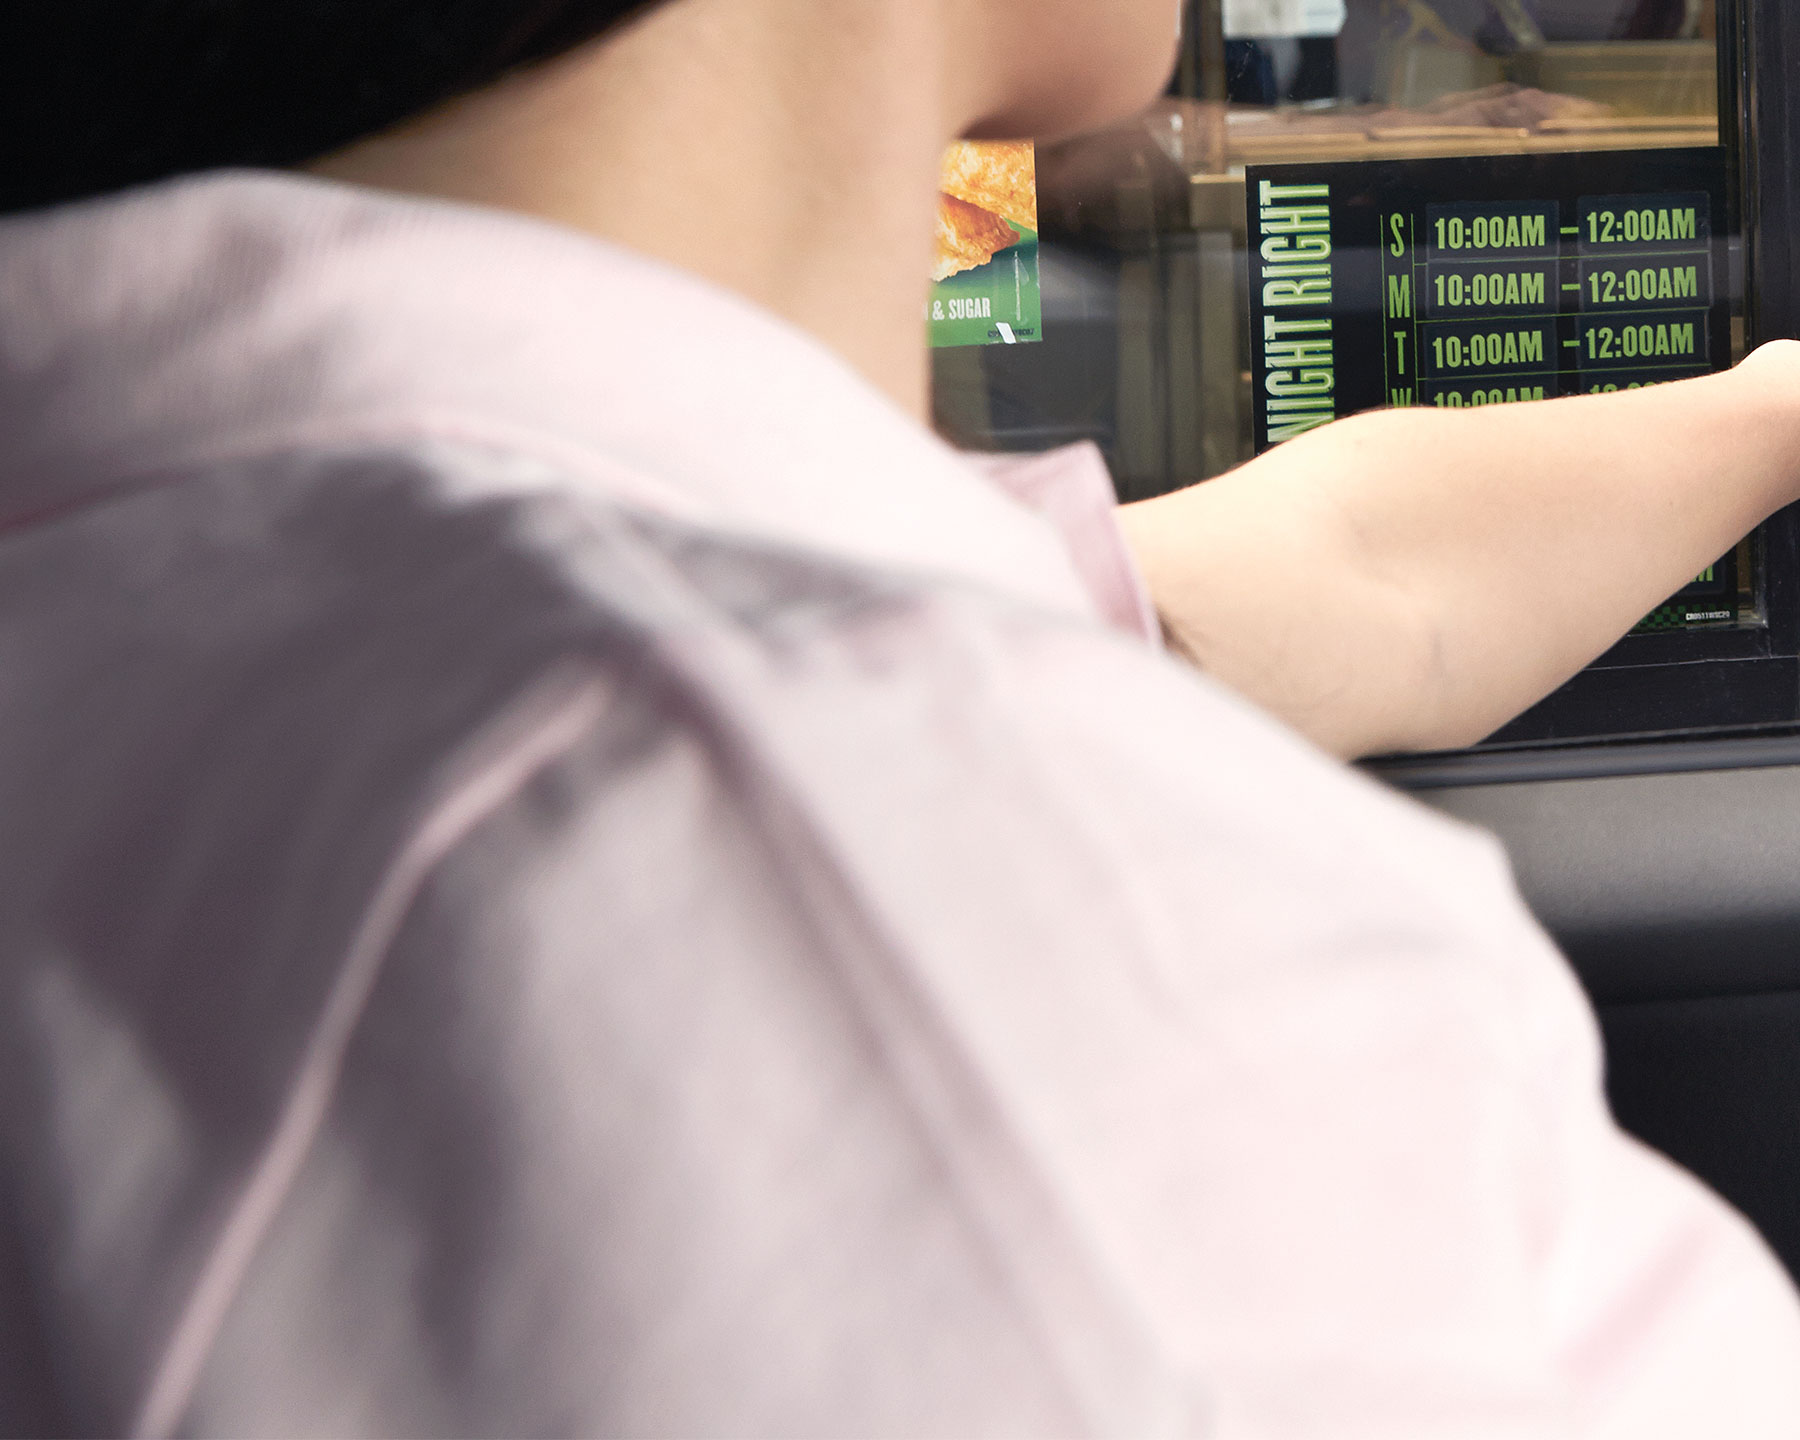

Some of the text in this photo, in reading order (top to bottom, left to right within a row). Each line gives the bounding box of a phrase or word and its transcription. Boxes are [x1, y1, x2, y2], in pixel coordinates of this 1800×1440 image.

[1390, 212, 1406, 257] S
[1434, 214, 1546, 250] 10:00AM
[1586, 207, 1697, 244] 12:00AM
[932, 299, 946, 321] &
[948, 298, 991, 320] SUGAR
[1259, 179, 1336, 443] NIGHT RIGHT
[1388, 274, 1411, 319] M
[1434, 272, 1545, 307] 10:00AM
[1588, 265, 1698, 304] 12:00AM
[1393, 330, 1408, 375] T
[1432, 330, 1544, 369] 10:00AM
[1584, 322, 1695, 360] 12:00AM
